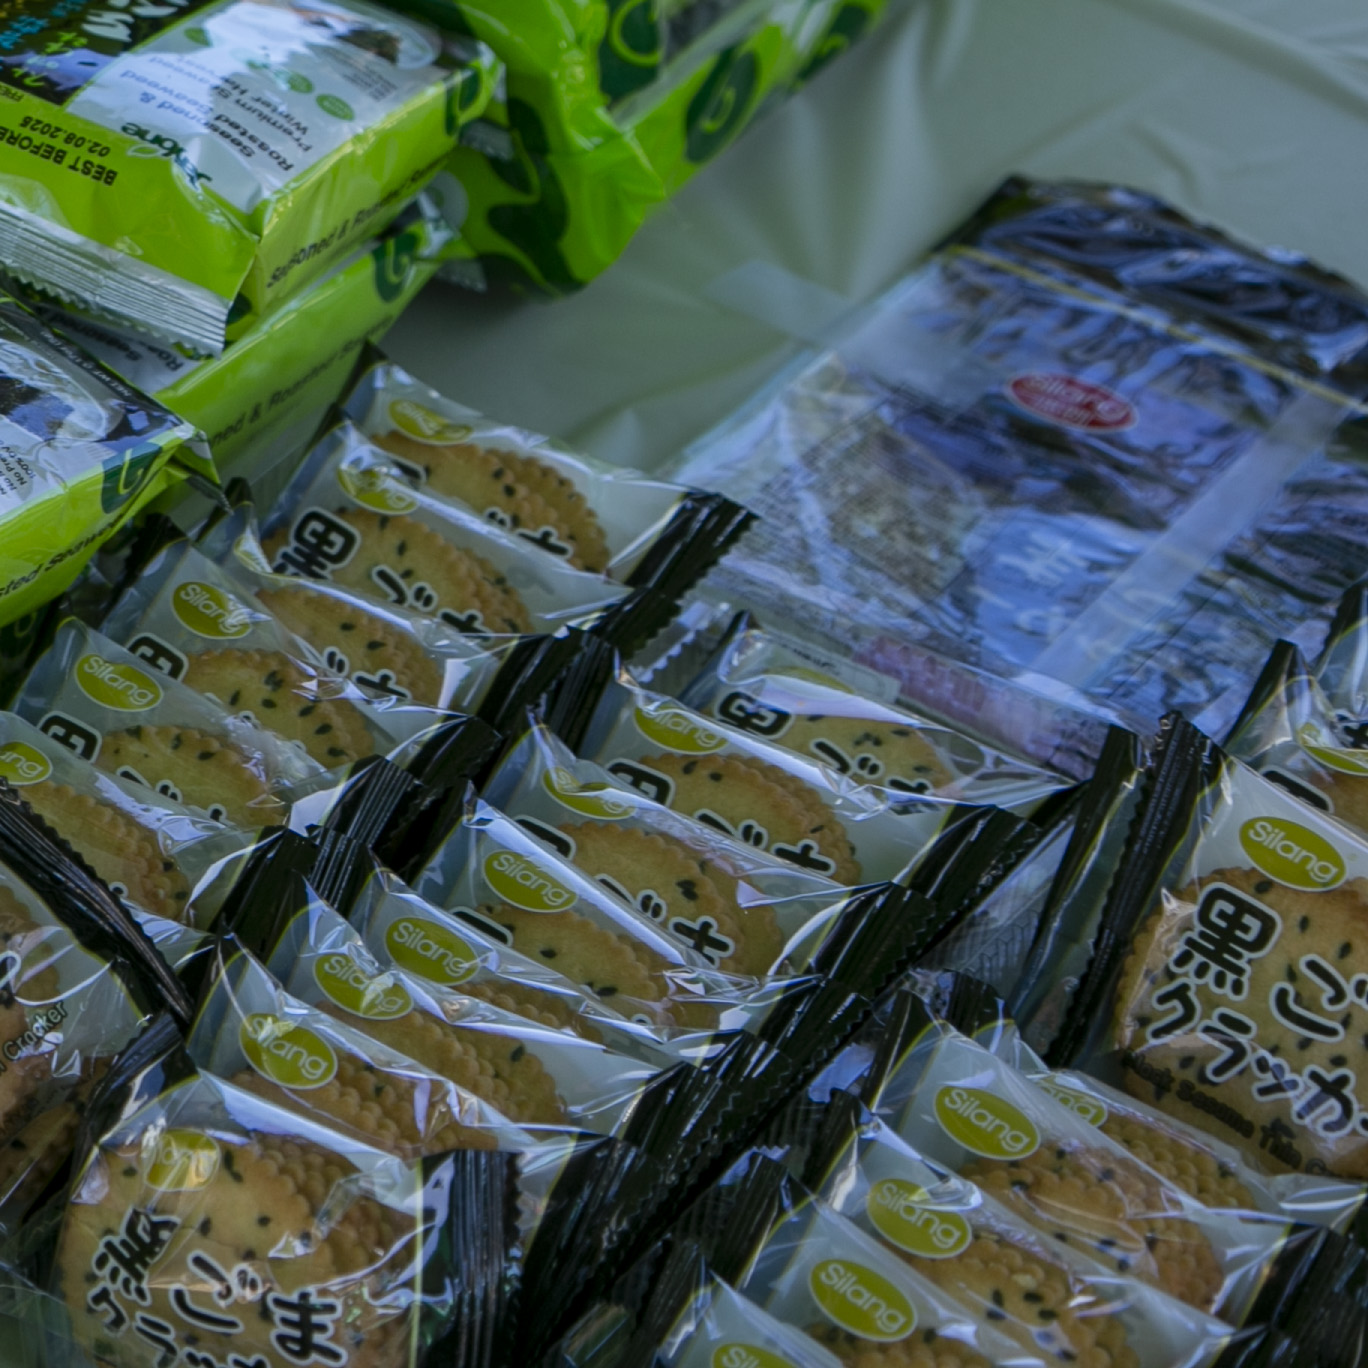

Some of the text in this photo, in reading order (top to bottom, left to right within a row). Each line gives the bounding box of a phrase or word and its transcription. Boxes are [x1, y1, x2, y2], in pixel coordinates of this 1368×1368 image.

[62, 155, 124, 184] BEST
[176, 583, 250, 637] Silang
[83, 656, 157, 708] Silang
[493, 854, 570, 907] Silang
[1248, 821, 1338, 883] Silang
[392, 922, 470, 979] Silang
[1171, 881, 1368, 1041] 黒ご
[1, 1000, 70, 1062] Cracker
[1149, 979, 1368, 1136] クラッカ
[944, 1090, 1031, 1153] Silang
[818, 1262, 908, 1335] Silang
